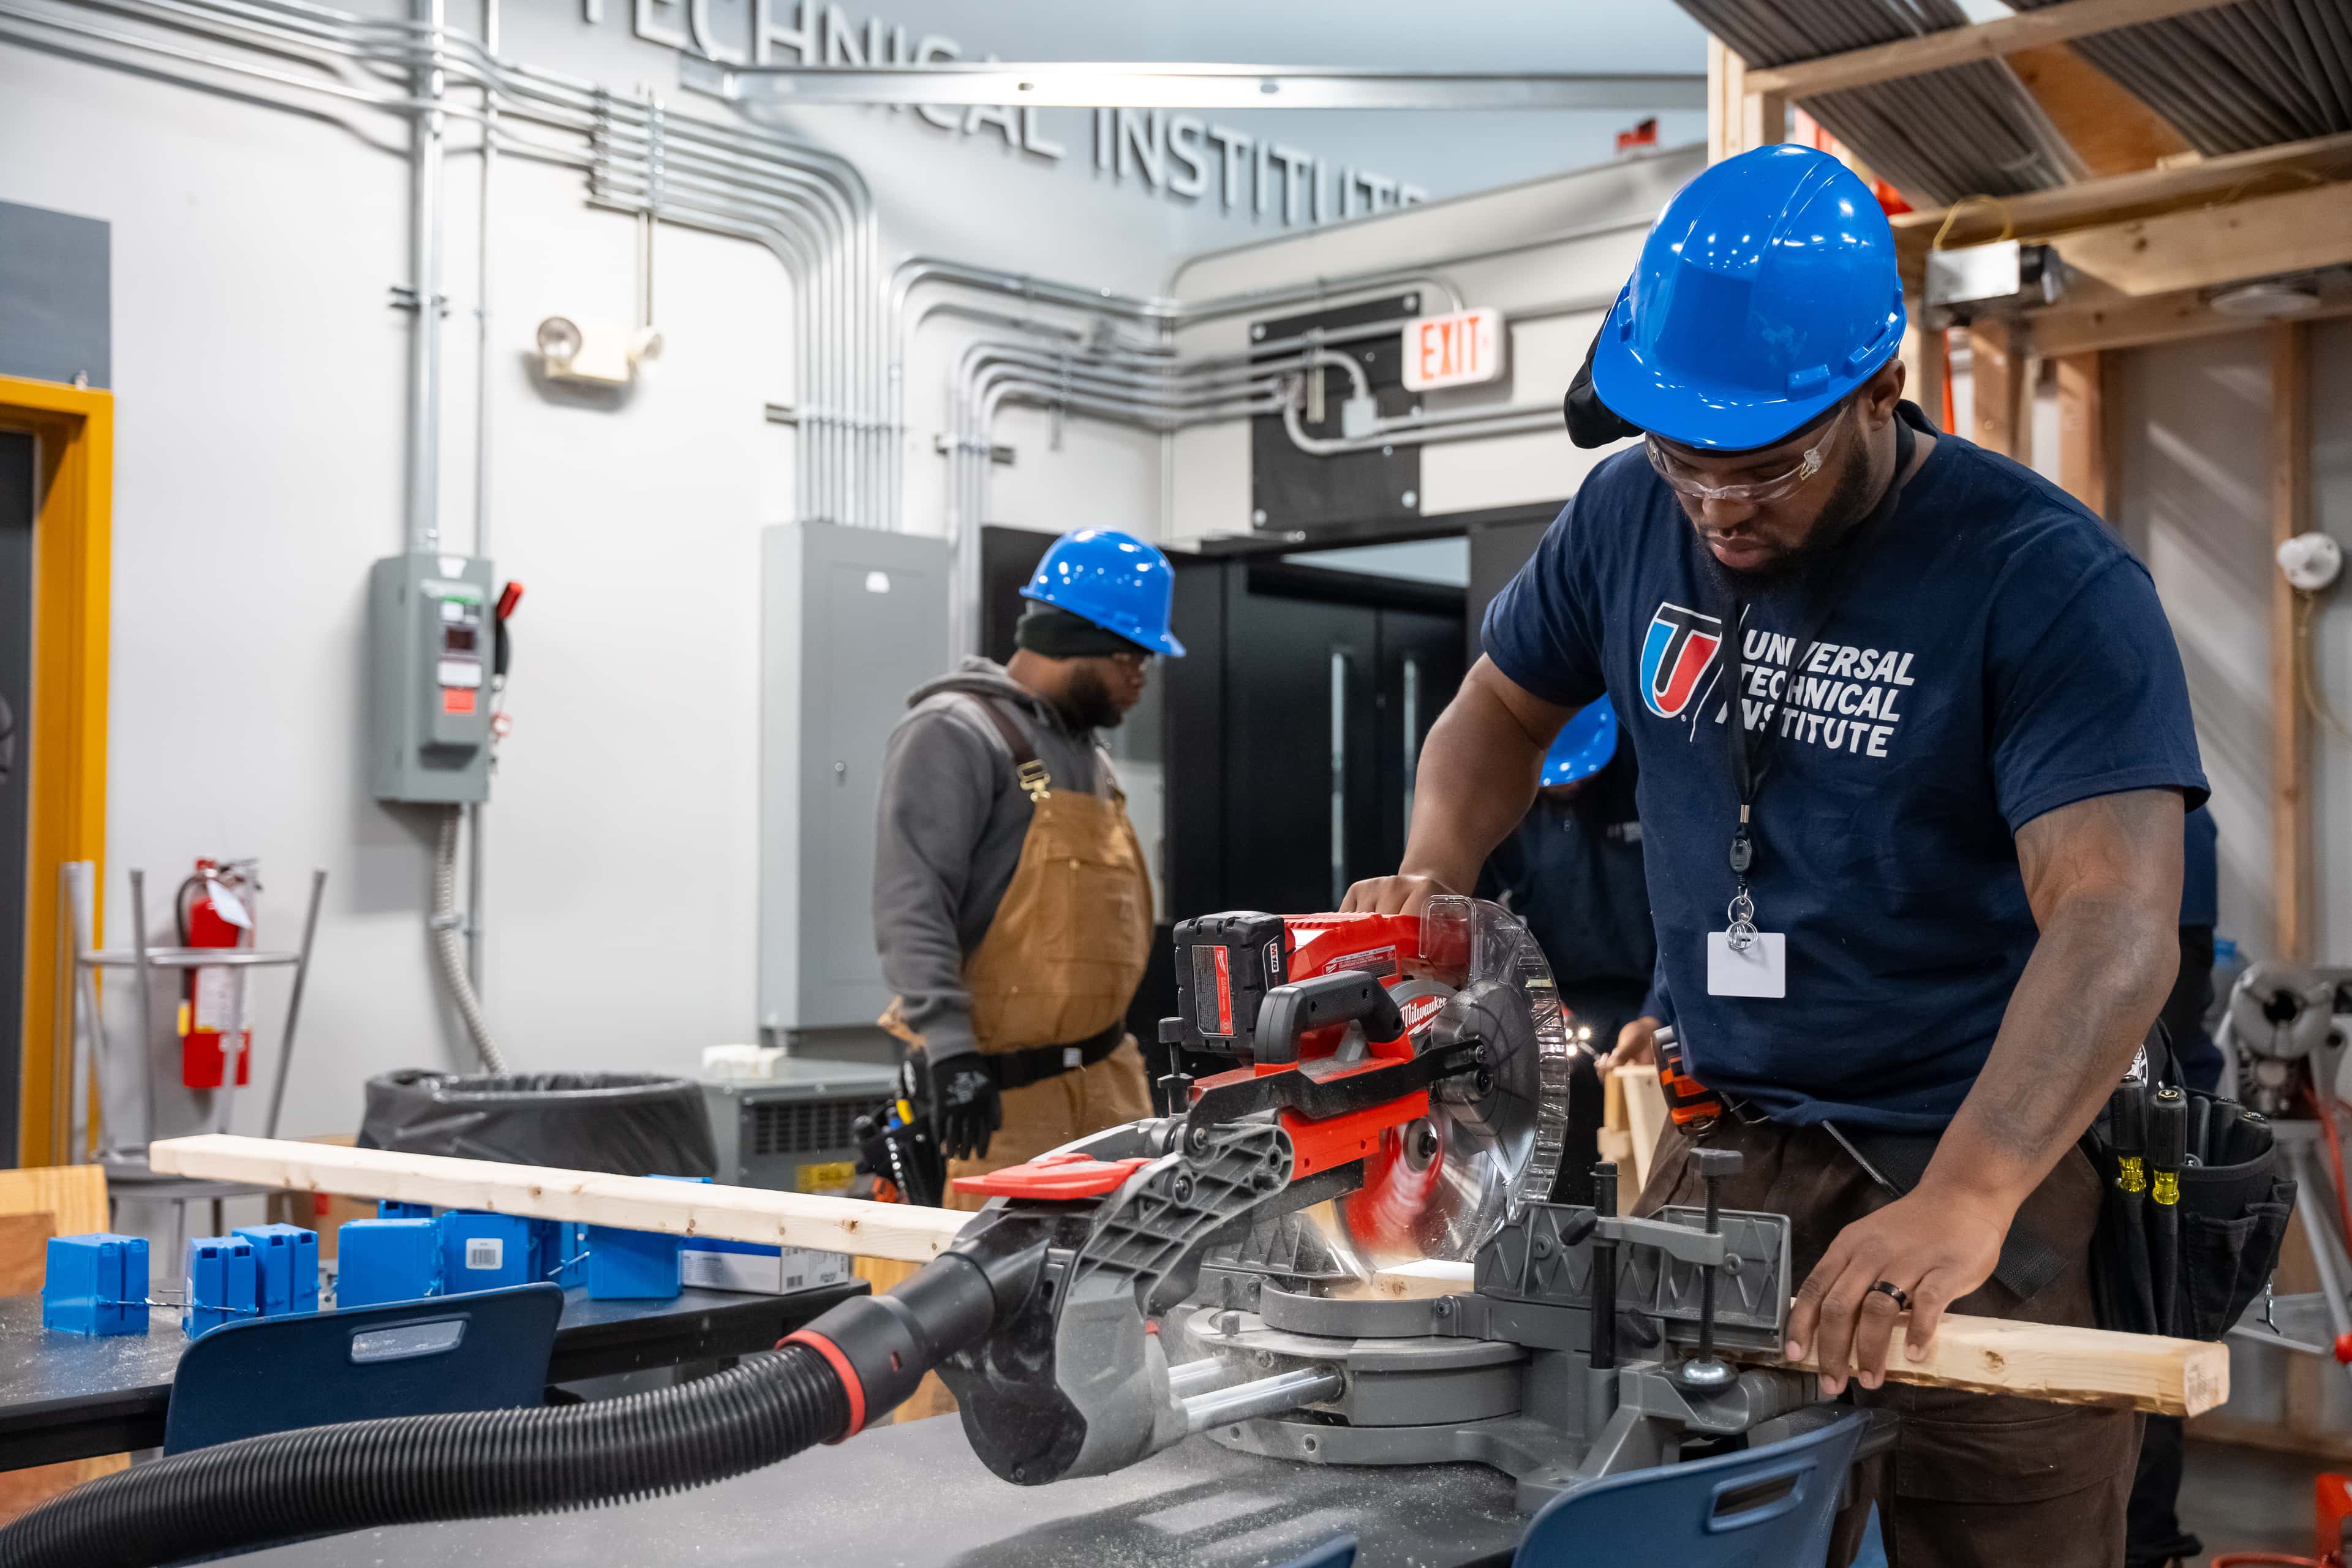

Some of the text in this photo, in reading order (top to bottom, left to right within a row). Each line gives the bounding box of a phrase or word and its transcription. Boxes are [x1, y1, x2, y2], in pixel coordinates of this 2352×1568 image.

[586, 0, 1066, 160] ECHNICAL
[1420, 316, 1480, 381] EXIT
[1400, 996, 1447, 1028] Milwaukee
